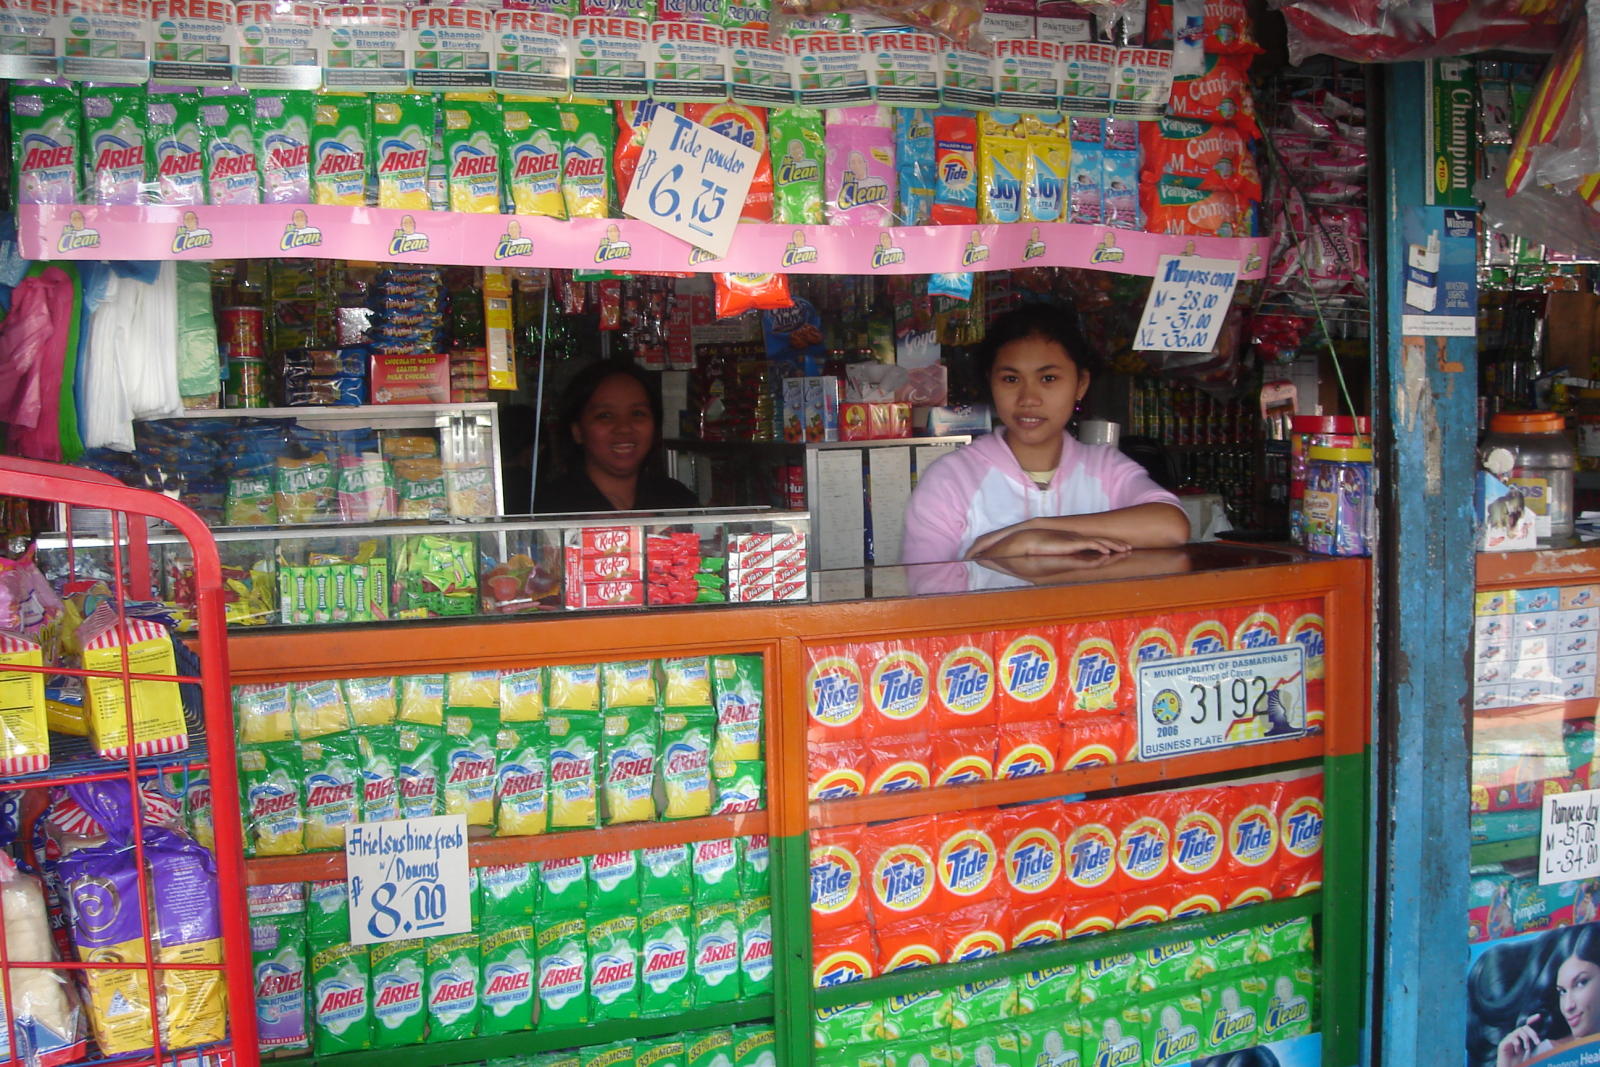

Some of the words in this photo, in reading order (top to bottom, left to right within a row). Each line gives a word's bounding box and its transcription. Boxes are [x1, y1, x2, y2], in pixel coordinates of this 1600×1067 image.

[151, 0, 232, 26] FREE!
[412, 8, 490, 30] FREE!
[495, 10, 568, 36] FREE!
[985, 17, 1023, 27] PANTENE
[573, 18, 647, 40] FREE!
[651, 22, 725, 45] FREE!
[1041, 23, 1077, 32] PANTENE
[793, 34, 865, 54] FREE!
[868, 34, 936, 53] FREE!
[996, 40, 1059, 60] FREE!
[1063, 43, 1116, 64] FREE!
[670, 116, 699, 158] Tide
[701, 142, 745, 173] powder
[1187, 132, 1243, 159] Comfort
[1447, 88, 1473, 188] Champion
[22, 146, 73, 171] ARIEL
[96, 145, 144, 171] ARIEL
[316, 152, 365, 174] ARIEL
[380, 150, 427, 172] ARIEL
[453, 155, 498, 177] ARIEL
[512, 154, 558, 177] ARIEL
[564, 158, 604, 178] ARIEL
[778, 164, 818, 186] Clean
[945, 163, 968, 182] Tide
[649, 164, 728, 222] 6.75
[838, 184, 887, 210] Clean
[57, 233, 99, 253] Clean
[171, 233, 212, 254] Clean
[280, 232, 322, 251] Clean
[388, 237, 429, 255] Clean
[494, 241, 533, 260] Clean
[594, 245, 632, 263] Clean
[781, 249, 817, 267] Clean
[871, 250, 905, 269] Clean
[1164, 260, 1210, 288] Pampers
[409, 480, 443, 500] TANG
[596, 531, 626, 549] KitKat
[596, 557, 626, 574] KitKat
[600, 582, 630, 602] KitKat
[1008, 653, 1050, 692] Tide
[1076, 654, 1115, 692] Tide
[1154, 662, 1215, 678] MUNICIPALITY
[1188, 673, 1219, 682] Province
[1222, 670, 1229, 678] of
[1230, 669, 1253, 677] Cavite
[814, 674, 859, 716] Tide
[879, 670, 924, 709] Tide
[945, 664, 987, 705] Tide
[1190, 676, 1268, 724] 3192
[720, 704, 759, 724] ARIEL
[1157, 725, 1178, 738] 2006
[1146, 739, 1191, 754] BUSINESS
[1193, 735, 1223, 747] PLATE
[449, 759, 496, 783] ARIEL
[552, 760, 591, 782] ARIEL
[608, 756, 654, 784] ARIEL
[664, 750, 708, 773] ARIEL
[499, 771, 543, 796] ARIEL
[251, 792, 298, 818] ARIEL
[1235, 821, 1272, 857] Tide
[1288, 813, 1323, 849] Tide
[1546, 833, 1555, 851] M
[696, 840, 733, 863] ARIEL
[1126, 835, 1163, 869] Tide
[1177, 826, 1216, 861] Tide
[396, 857, 438, 883] Downy
[946, 850, 988, 888] Tide
[1011, 847, 1053, 885] Tide
[1069, 839, 1110, 881] Tide
[1546, 858, 1553, 873] L
[883, 862, 926, 904] Tide
[368, 882, 446, 938] 8.00
[645, 950, 686, 973] ARIEL
[699, 942, 736, 966] ARIEL
[256, 971, 303, 998] ARIEL
[486, 972, 529, 996] ARIEL
[543, 965, 582, 987] ARIEL
[593, 962, 633, 985] ARIEL
[319, 987, 364, 1015] ARIEL
[376, 981, 421, 1007] ARIEL
[432, 979, 474, 1005] ARIEL
[1264, 1002, 1308, 1033] Clean
[1210, 1015, 1255, 1047] Clean
[1095, 1043, 1138, 1067] Clean
[1152, 1030, 1195, 1066] Clean
